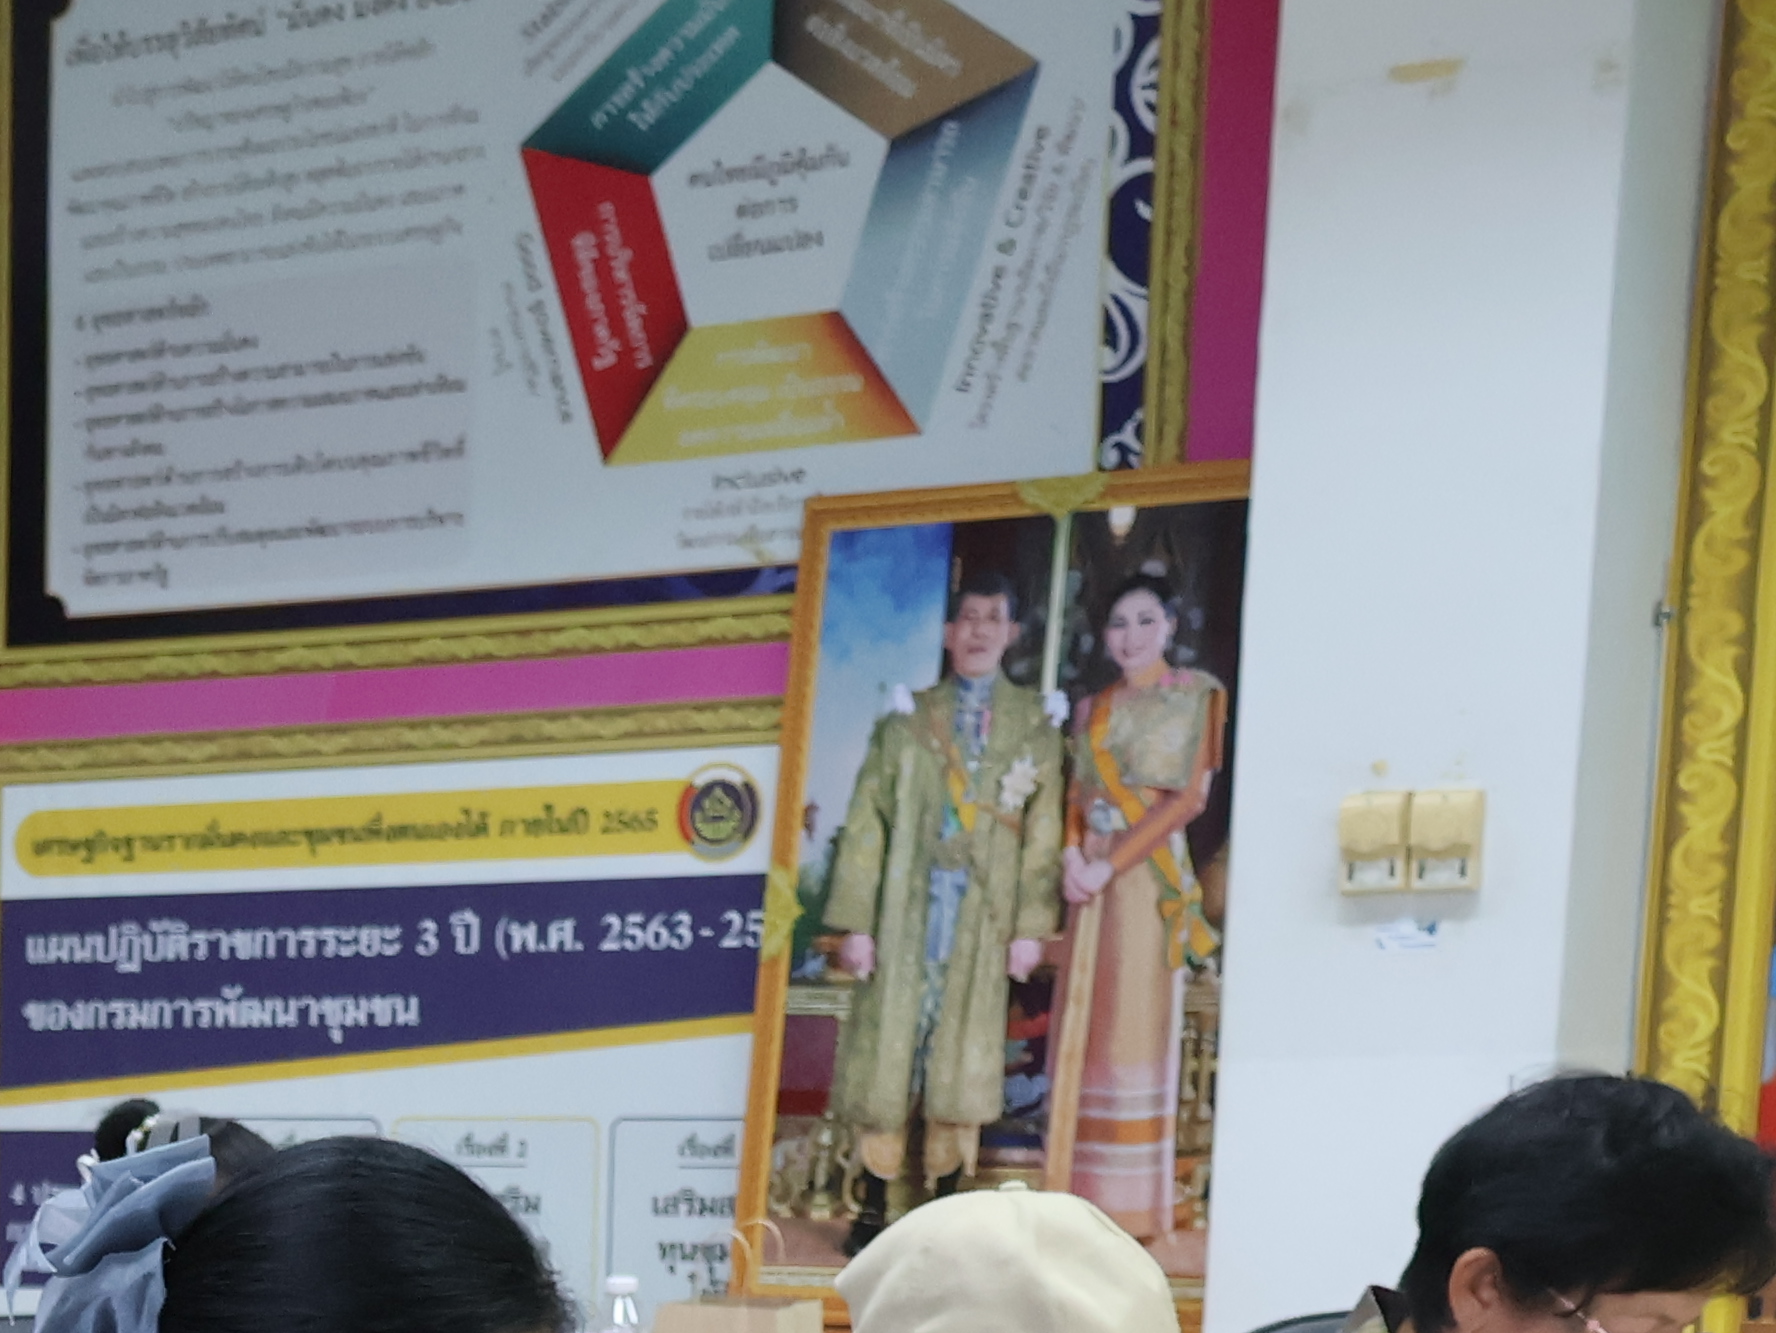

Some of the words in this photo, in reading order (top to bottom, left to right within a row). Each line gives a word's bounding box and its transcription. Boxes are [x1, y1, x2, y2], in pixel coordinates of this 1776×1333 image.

[25, 917, 403, 974] แผนปฏิบัติราชการระยะ
[415, 920, 438, 958] 3
[448, 910, 482, 957] ปี
[21, 982, 421, 1045] ของกรมการพัฒนาชุมชน
